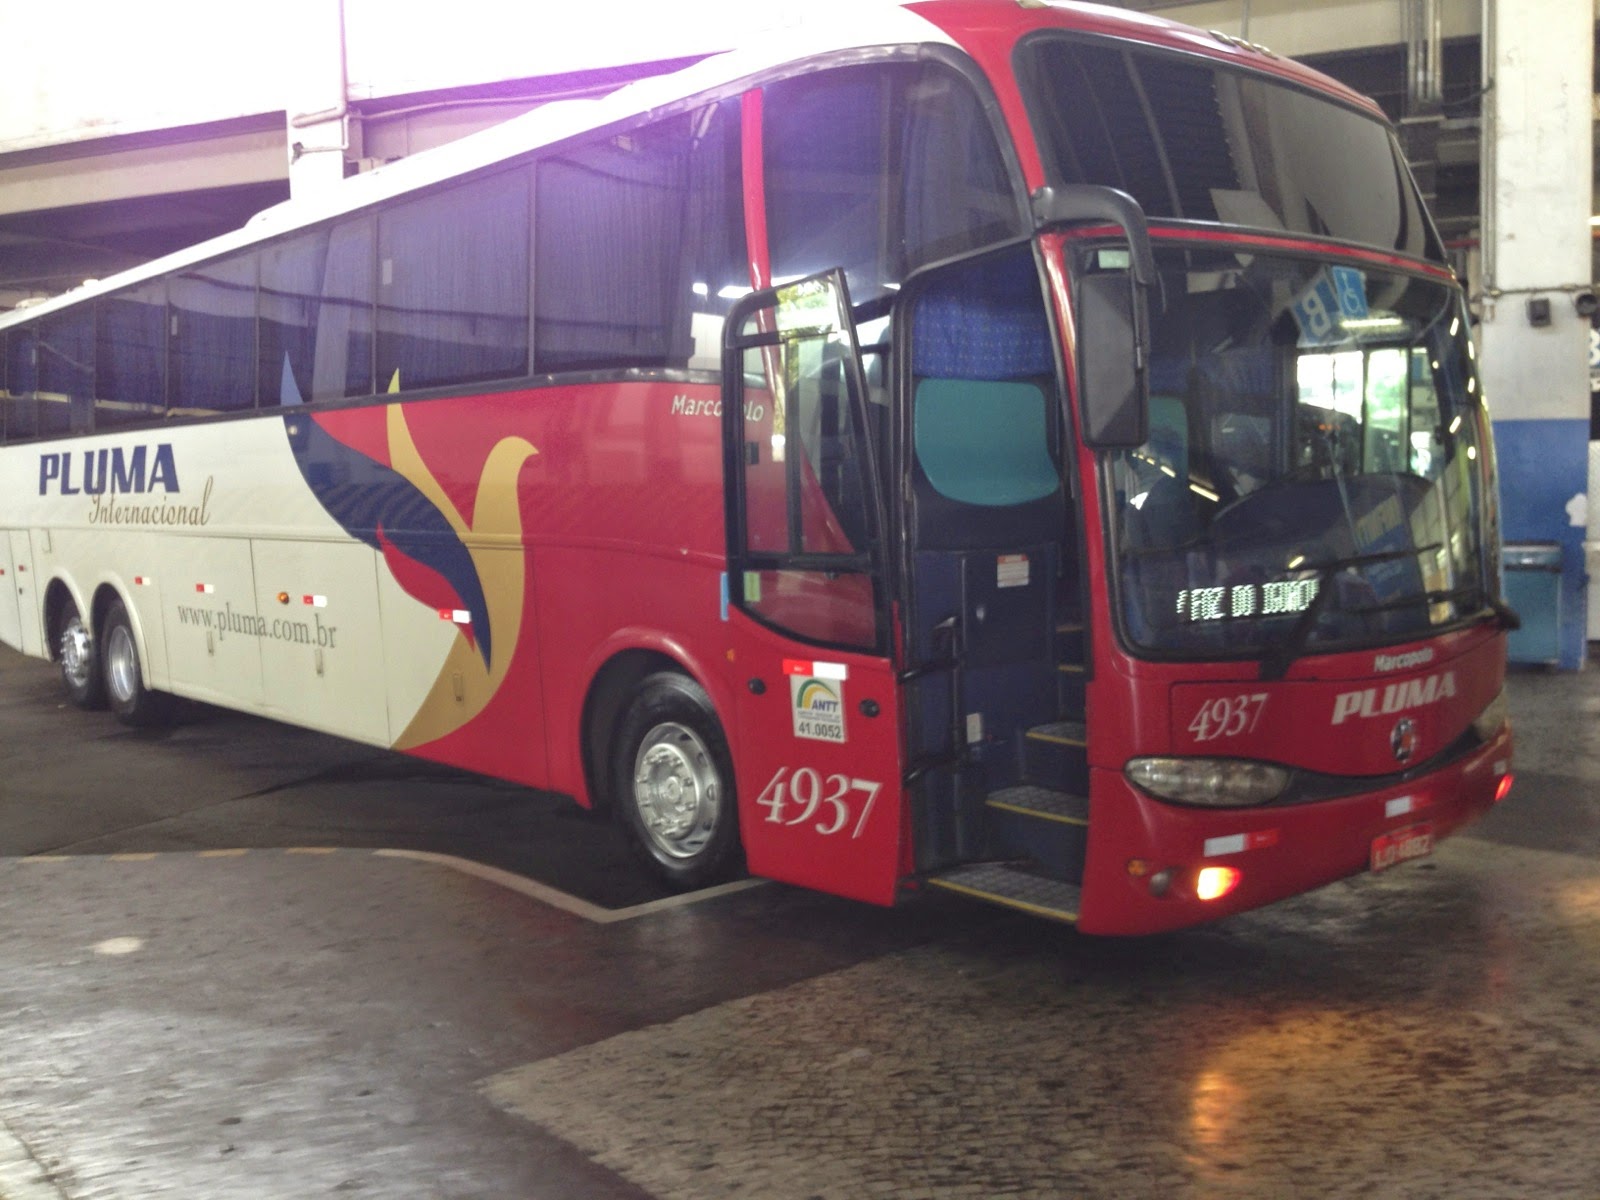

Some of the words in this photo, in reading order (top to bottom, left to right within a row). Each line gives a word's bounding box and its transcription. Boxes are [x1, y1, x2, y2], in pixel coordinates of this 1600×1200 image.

[671, 394, 764, 421] Marcolo
[39, 443, 180, 496] PLUMA
[88, 475, 213, 526] Internacional
[177, 602, 337, 649] www.pluma.com.br
[811, 699, 839, 713] ANTT
[1187, 692, 1269, 742] 4937
[1331, 671, 1456, 725] PLUMA
[798, 721, 842, 740] 41.0052
[756, 766, 883, 839] 4937
